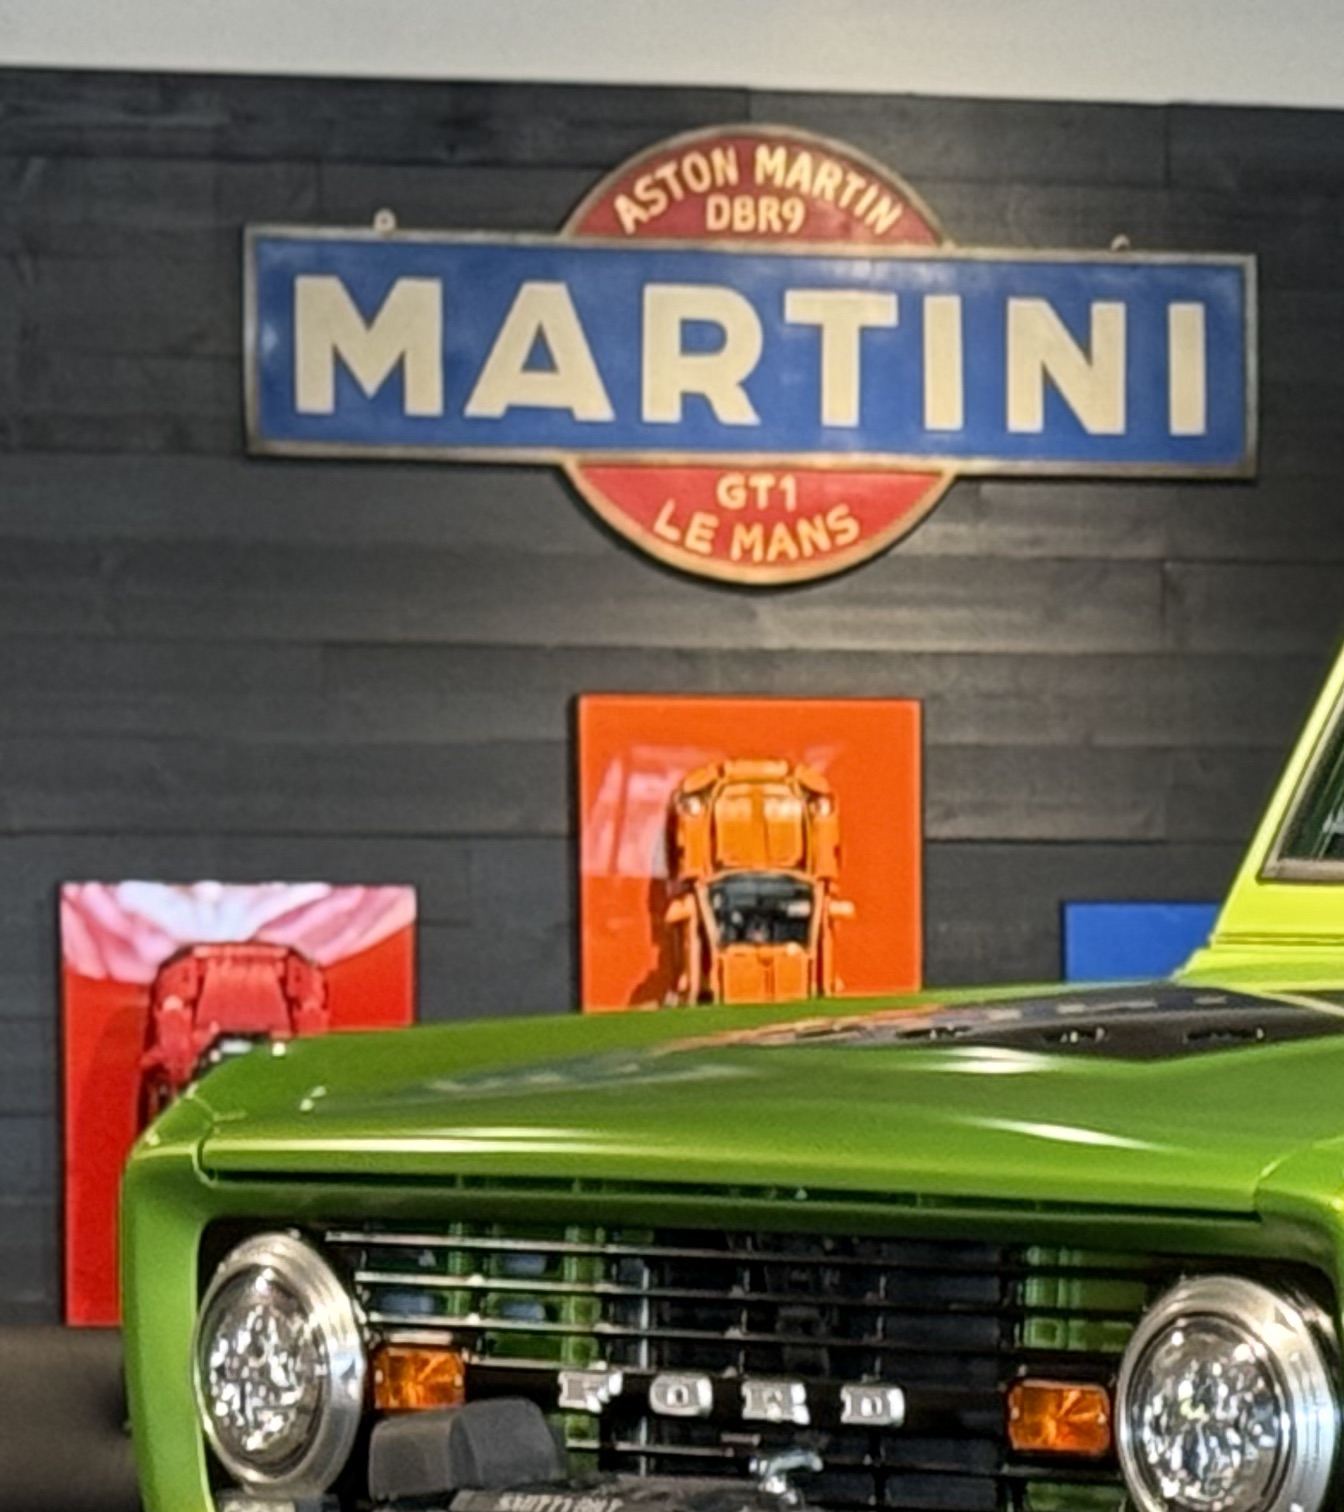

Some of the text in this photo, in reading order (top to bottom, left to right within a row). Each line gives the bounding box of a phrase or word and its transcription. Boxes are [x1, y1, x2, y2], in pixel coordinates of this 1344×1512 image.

[613, 144, 903, 235] ASTON MARTIN
[704, 196, 806, 233] DBR9
[293, 275, 1207, 436] MARTINI
[716, 474, 797, 511] GT1
[653, 498, 861, 562] LE MANS
[558, 1370, 904, 1425] FORD
